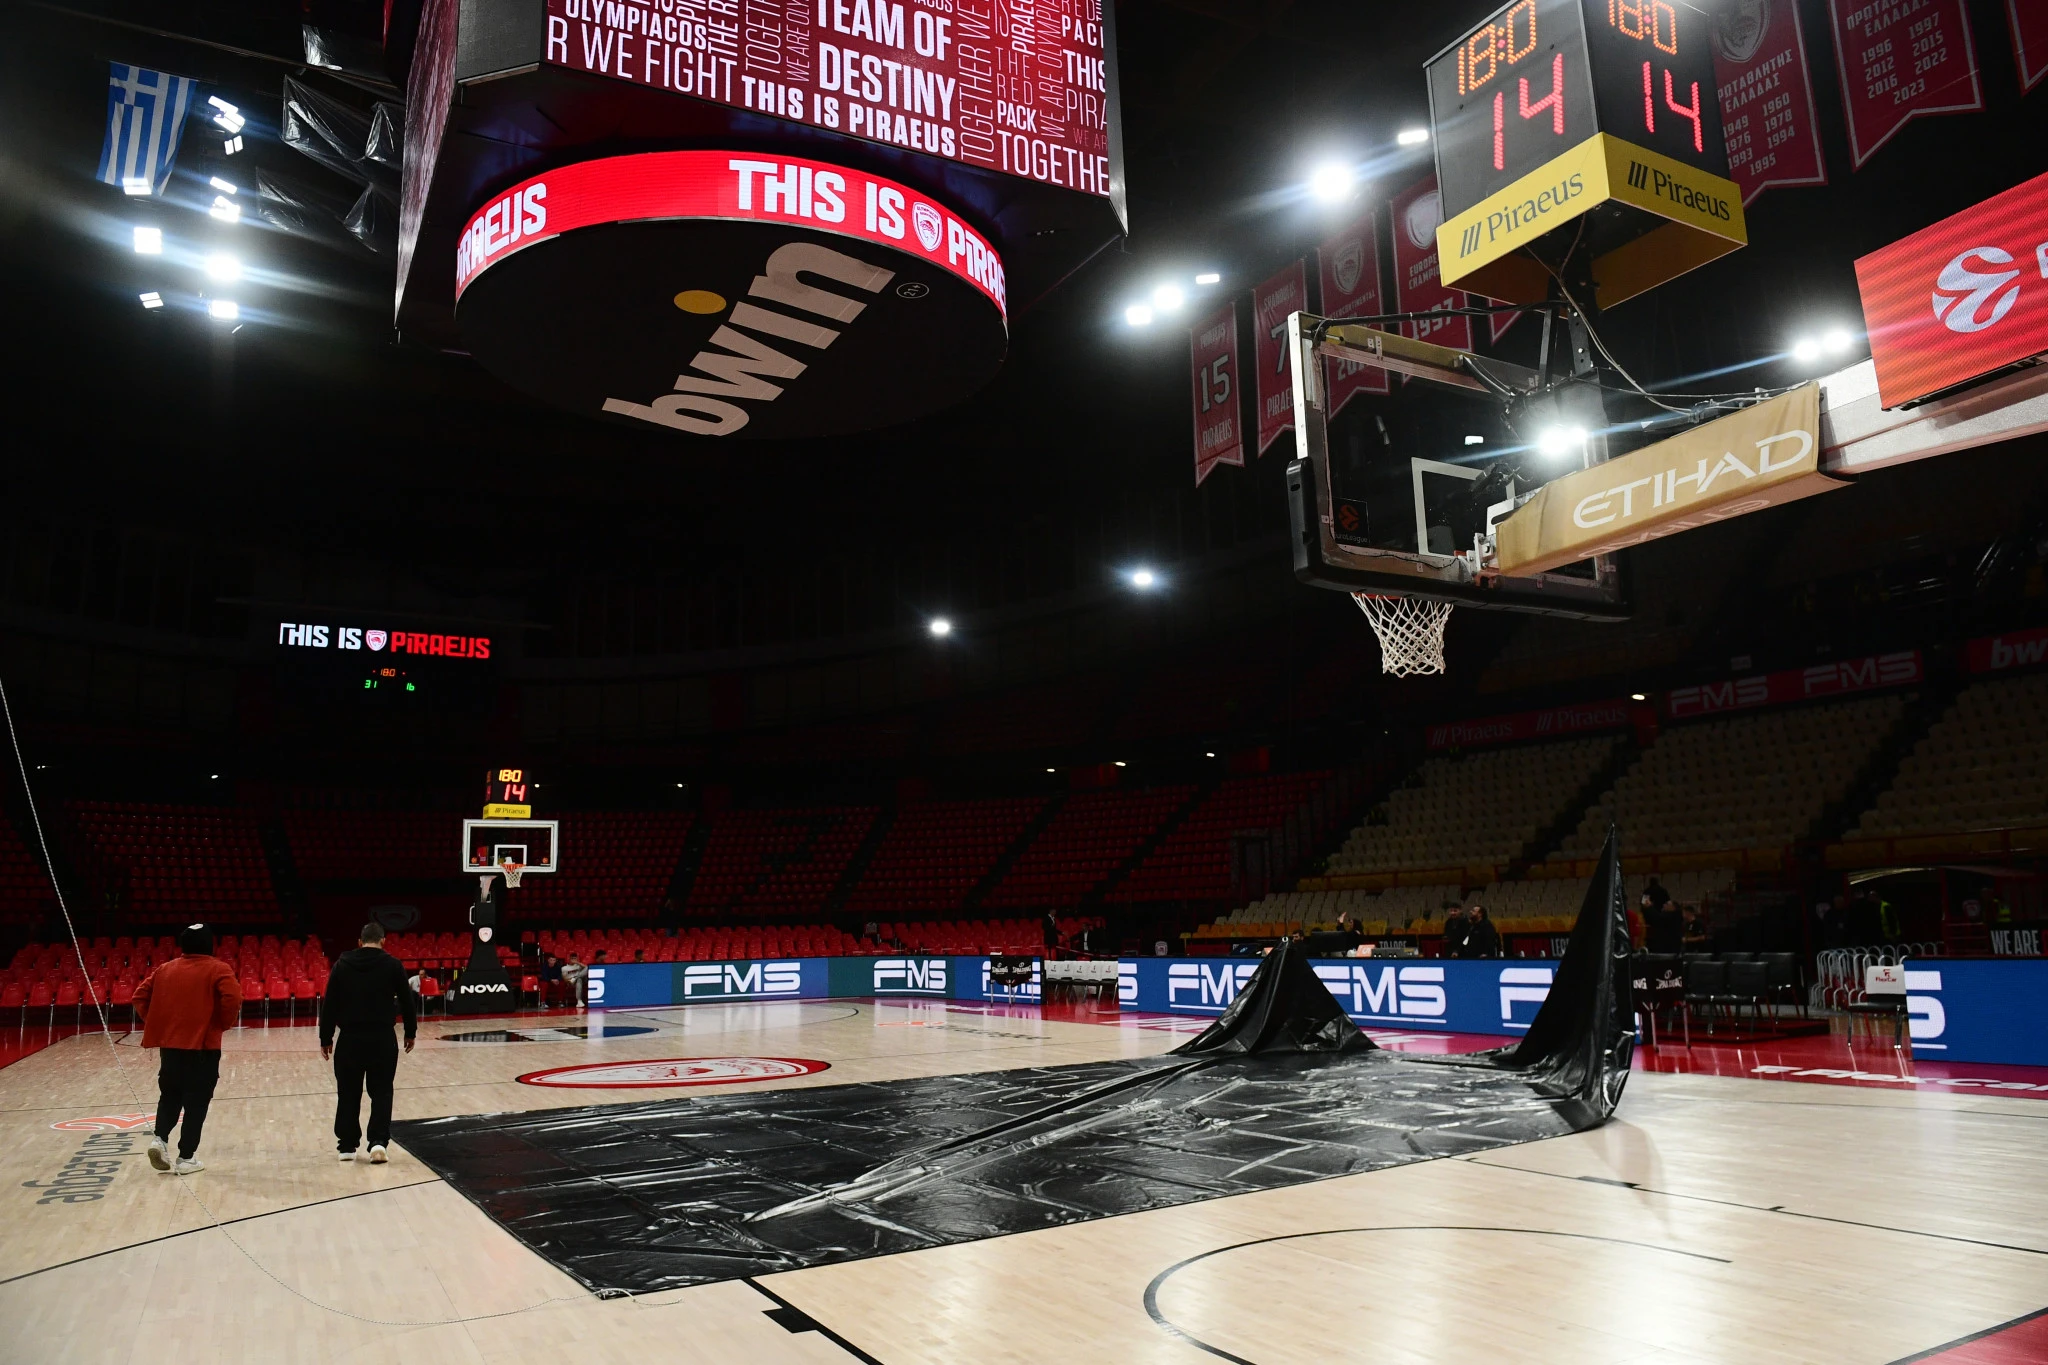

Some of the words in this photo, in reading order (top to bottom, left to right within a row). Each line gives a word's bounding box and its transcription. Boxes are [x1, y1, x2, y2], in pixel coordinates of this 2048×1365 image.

[708, 15, 739, 57] THE
[786, 24, 810, 58] ARE
[913, 10, 952, 61] OF
[1061, 14, 1104, 49] PAC
[1908, 11, 1940, 40] 1997
[1862, 38, 1893, 65] 1996
[1912, 30, 1944, 57] 2015
[581, 23, 634, 79] WE
[645, 39, 738, 102] FIGHT
[786, 56, 810, 82] WE
[994, 46, 1031, 80] THE
[1865, 55, 1895, 82] 2012
[1914, 47, 1948, 75] 2022
[819, 42, 956, 121] DESTINY
[996, 73, 1034, 106] RED
[1038, 70, 1064, 109] ARE
[1867, 73, 1898, 99] 2016
[1893, 78, 1926, 105] 2023
[741, 75, 804, 120] THIS
[813, 93, 839, 128] IS
[849, 102, 956, 157] PIRAEUS
[957, 43, 995, 163] TOGETHER
[997, 100, 1038, 134] PACK
[1493, 53, 1565, 171] 14
[1642, 61, 1704, 153] 14
[1762, 92, 1790, 117] 1960
[1040, 109, 1066, 139] WE
[1765, 108, 1793, 133] 1978
[1725, 131, 1751, 154] 1976
[1767, 125, 1796, 150] 1994
[996, 129, 1110, 196] TOGETHE
[1728, 147, 1753, 170] 1993
[1749, 152, 1777, 177] 1995
[729, 159, 846, 223] THIS
[864, 180, 906, 240] IS
[1487, 171, 1584, 244] Piraeus
[1652, 169, 1731, 222] Piraeus
[903, 283, 921, 297] 21+
[601, 242, 897, 437] bwin
[1200, 354, 1231, 413] 15
[1202, 418, 1232, 450] PIRAEUS
[1573, 430, 1813, 529] ETIHAD
[279, 622, 330, 648] THIS
[338, 627, 362, 650] IS
[390, 631, 491, 659] PIRAEUS
[1803, 651, 1917, 693] FMS
[1670, 675, 1769, 715] FMS
[1451, 721, 1513, 743] Piraeus
[1557, 707, 1627, 729] Piraeus
[504, 784, 526, 802] 14
[1990, 930, 2012, 955] WE
[2014, 930, 2041, 955] ARE
[460, 984, 509, 994] NOVA
[684, 962, 801, 995] FMS
[874, 960, 946, 989] FMS
[1312, 965, 1447, 1016] FMS
